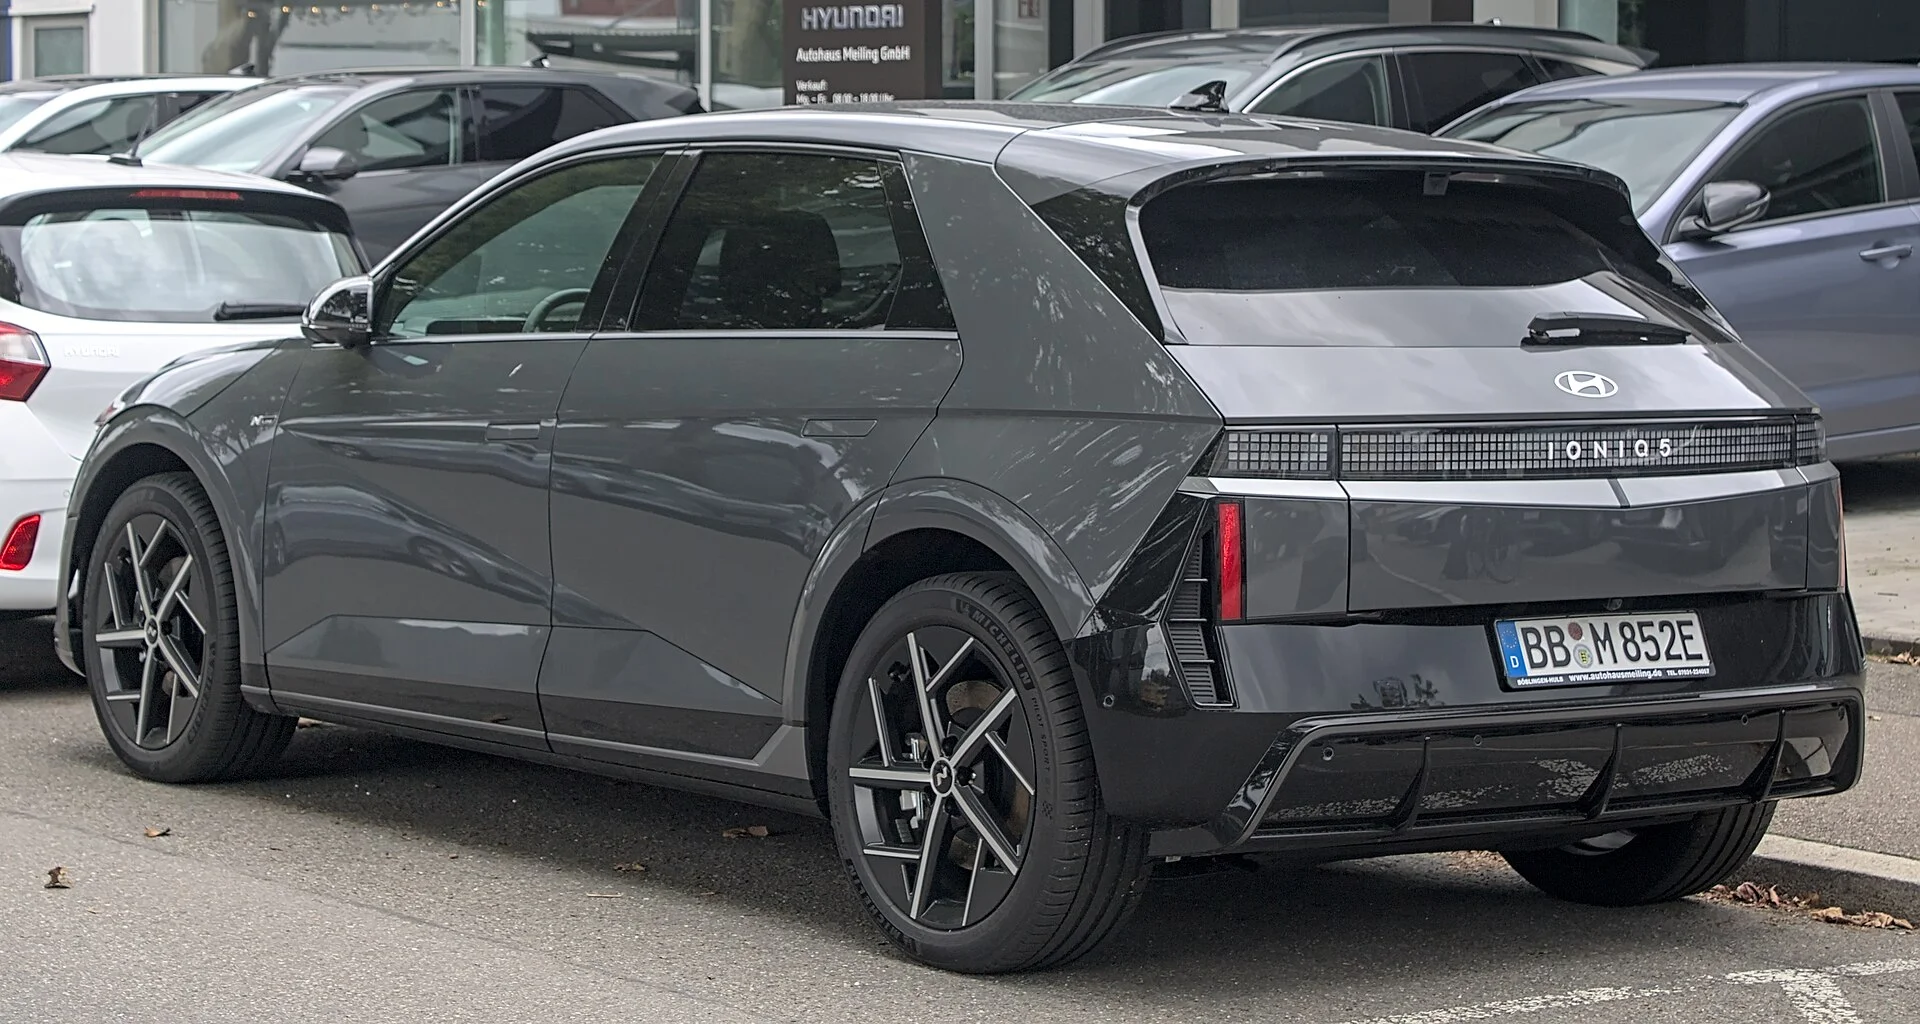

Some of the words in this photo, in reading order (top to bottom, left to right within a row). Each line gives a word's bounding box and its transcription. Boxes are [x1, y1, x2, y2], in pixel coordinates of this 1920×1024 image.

[802, 5, 904, 30] HYUNDAI
[796, 48, 841, 62] Autohaus
[843, 46, 879, 64] Meiling
[880, 45, 911, 61] GmbH
[972, 611, 1032, 686] MICHELIN
[1521, 625, 1571, 669] BB
[1589, 622, 1618, 664] M
[1619, 619, 1704, 662] 852E
[1510, 655, 1520, 669] D
[1569, 670, 1662, 682] www.autohausmeiling.de
